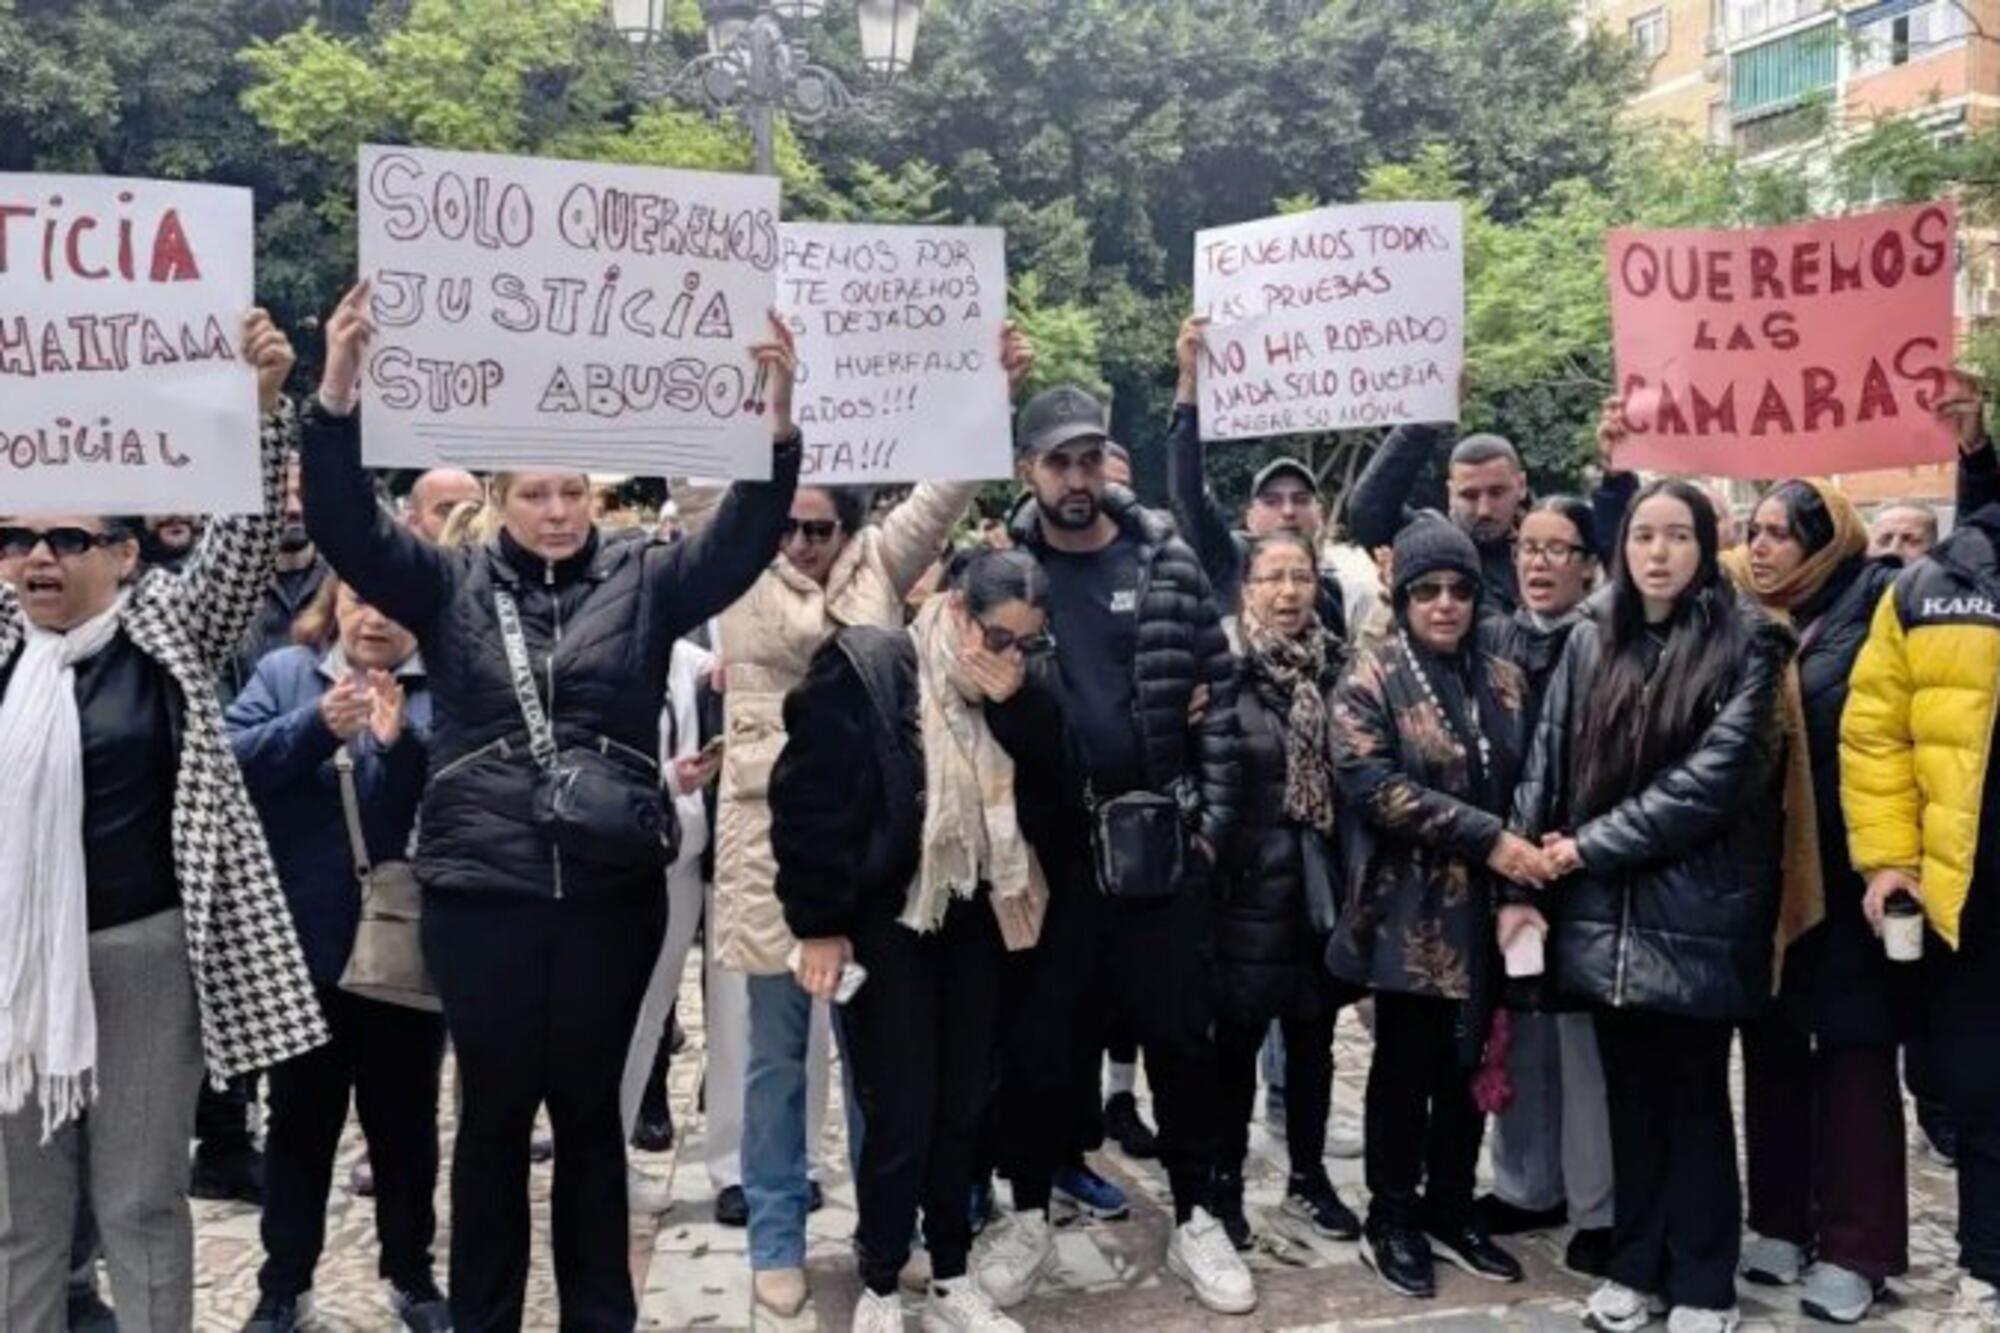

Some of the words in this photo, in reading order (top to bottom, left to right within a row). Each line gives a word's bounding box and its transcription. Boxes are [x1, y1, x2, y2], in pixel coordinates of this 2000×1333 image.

[370, 153, 533, 248] SOLO
[559, 183, 778, 271] QUEREMOS
[916, 239, 975, 271] POR
[1204, 230, 1354, 275] TENEMOS
[1359, 225, 1449, 255] TODAS
[1621, 207, 1948, 302] QUEREMOS
[842, 275, 981, 304] QUEREMOS
[1262, 266, 1391, 313] PRUEBAS
[823, 304, 945, 336] DEJADO
[963, 302, 981, 320] A
[1694, 311, 1800, 350] LAS
[1206, 340, 1245, 379] NO
[1264, 331, 1315, 365] HA
[1325, 316, 1447, 352] ROBADO
[370, 347, 504, 411] STOP
[1214, 379, 1278, 412] NADA
[1284, 369, 1338, 400] SOLO
[1624, 337, 1946, 437] CAMARAS
[1306, 407, 1329, 426] SU
